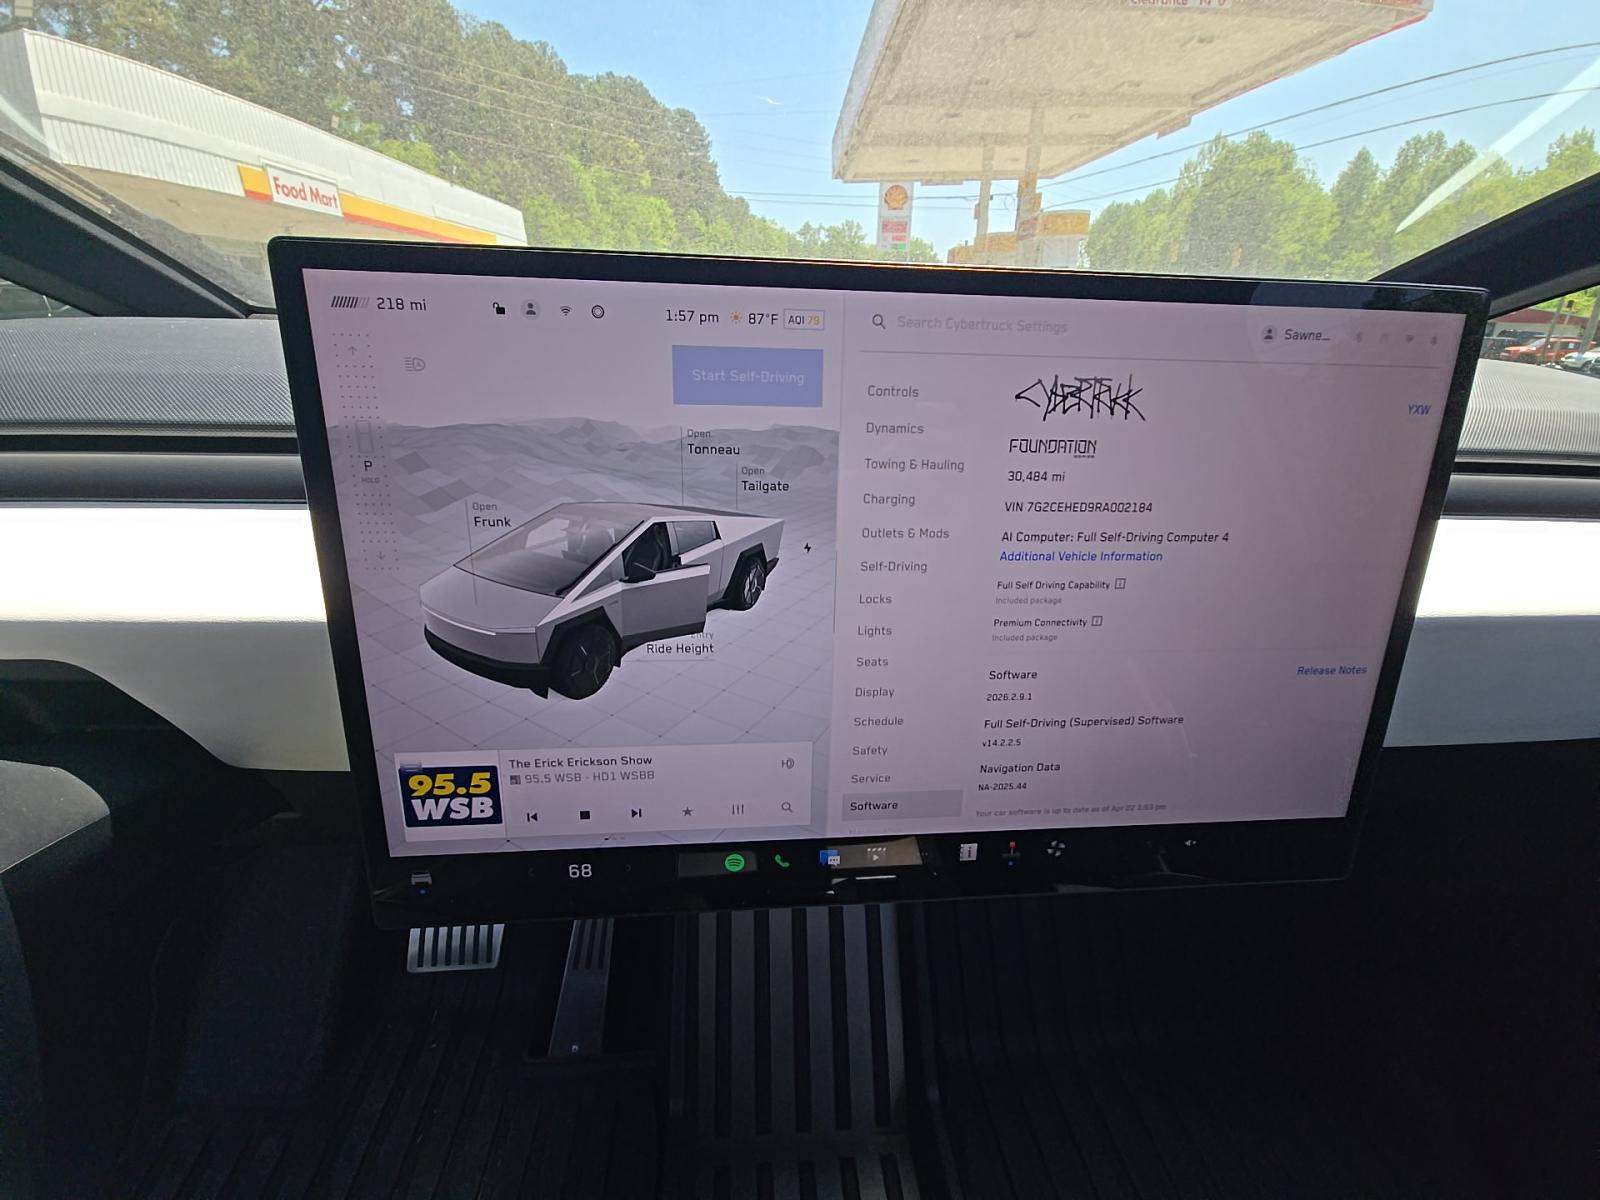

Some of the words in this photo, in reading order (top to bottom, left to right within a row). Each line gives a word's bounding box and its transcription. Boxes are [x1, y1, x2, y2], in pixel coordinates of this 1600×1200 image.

[273, 176, 308, 201] Food
[309, 185, 338, 208] Mart
[376, 298, 405, 310] 218
[410, 299, 427, 311] mi
[666, 309, 694, 322] 1:57
[700, 313, 719, 325] pm
[748, 313, 779, 325] 87°F
[897, 315, 942, 330] Search
[945, 317, 1013, 333] Cybertruck
[1016, 319, 1068, 336] Settings
[691, 368, 725, 382] Start
[730, 369, 805, 386] Self-Driving
[867, 384, 920, 398] Controls
[687, 428, 711, 439] Open
[866, 421, 926, 436] Dynamics
[687, 443, 741, 455] Tonneau
[1009, 438, 1098, 454] FOUNDATION
[364, 460, 373, 471] P
[741, 466, 766, 477] Open
[864, 458, 906, 472] Towing
[909, 459, 918, 470] &
[921, 459, 965, 473] Hauling
[1008, 470, 1048, 483] 30,484
[1052, 471, 1066, 482] mi
[741, 480, 790, 493] Tailgate
[863, 493, 916, 507] Charging
[1004, 501, 1024, 512] VIN
[472, 502, 498, 512] Open
[473, 516, 512, 528] Frunk
[862, 527, 905, 539] Outlets
[907, 528, 916, 538] &
[919, 528, 950, 539] Mods
[1001, 531, 1013, 542] AI
[1016, 531, 1074, 544] Computer:
[1077, 532, 1097, 542] Full
[1099, 532, 1164, 545] Self-Driving
[1166, 532, 1219, 545] Computer
[1222, 532, 1230, 542] 4
[999, 551, 1055, 562] Additional
[1058, 551, 1097, 562] Vehicle
[1100, 551, 1163, 562] Information
[860, 561, 928, 574] Self-Driving
[997, 581, 1013, 590] Full
[1016, 581, 1033, 590] Self
[1035, 581, 1066, 591] Driving
[1068, 580, 1111, 591] Capability
[859, 593, 893, 605] Locks
[1030, 597, 1062, 606] package
[993, 618, 1032, 627] Premium
[1034, 618, 1088, 628] Connectivity
[857, 625, 893, 638] Lights
[1026, 634, 1058, 643] package
[646, 643, 673, 654] Ride
[676, 643, 714, 656] Height
[856, 656, 889, 667] Seats
[988, 670, 1038, 680] Software
[1297, 665, 1336, 676] Release
[1338, 665, 1368, 675] Notes
[855, 686, 895, 699] Display
[986, 692, 1032, 702] 2026.2.9.1
[853, 715, 904, 727] Schedule
[984, 719, 1003, 729] Full
[1005, 718, 1066, 729] Self-Driving
[1069, 716, 1135, 728] (Supervised)
[1137, 715, 1184, 726] Software
[982, 738, 1022, 748] v14.2.2.5
[852, 744, 888, 757] Safety
[508, 759, 531, 769] The
[534, 758, 564, 769] Erick
[567, 756, 617, 768] Erickson
[620, 755, 653, 766] Show
[979, 763, 1034, 775] Navigation
[1036, 762, 1061, 773] Data
[524, 773, 551, 784] 95.5
[554, 772, 582, 783] WSB
[593, 771, 616, 782] HD1
[619, 770, 655, 781] WSBB
[851, 774, 891, 784] Service
[408, 771, 492, 797] 95.5
[978, 782, 1027, 791] NA-2025.44
[411, 797, 494, 821] WSB
[850, 801, 899, 812] Software
[569, 863, 592, 878] 68
